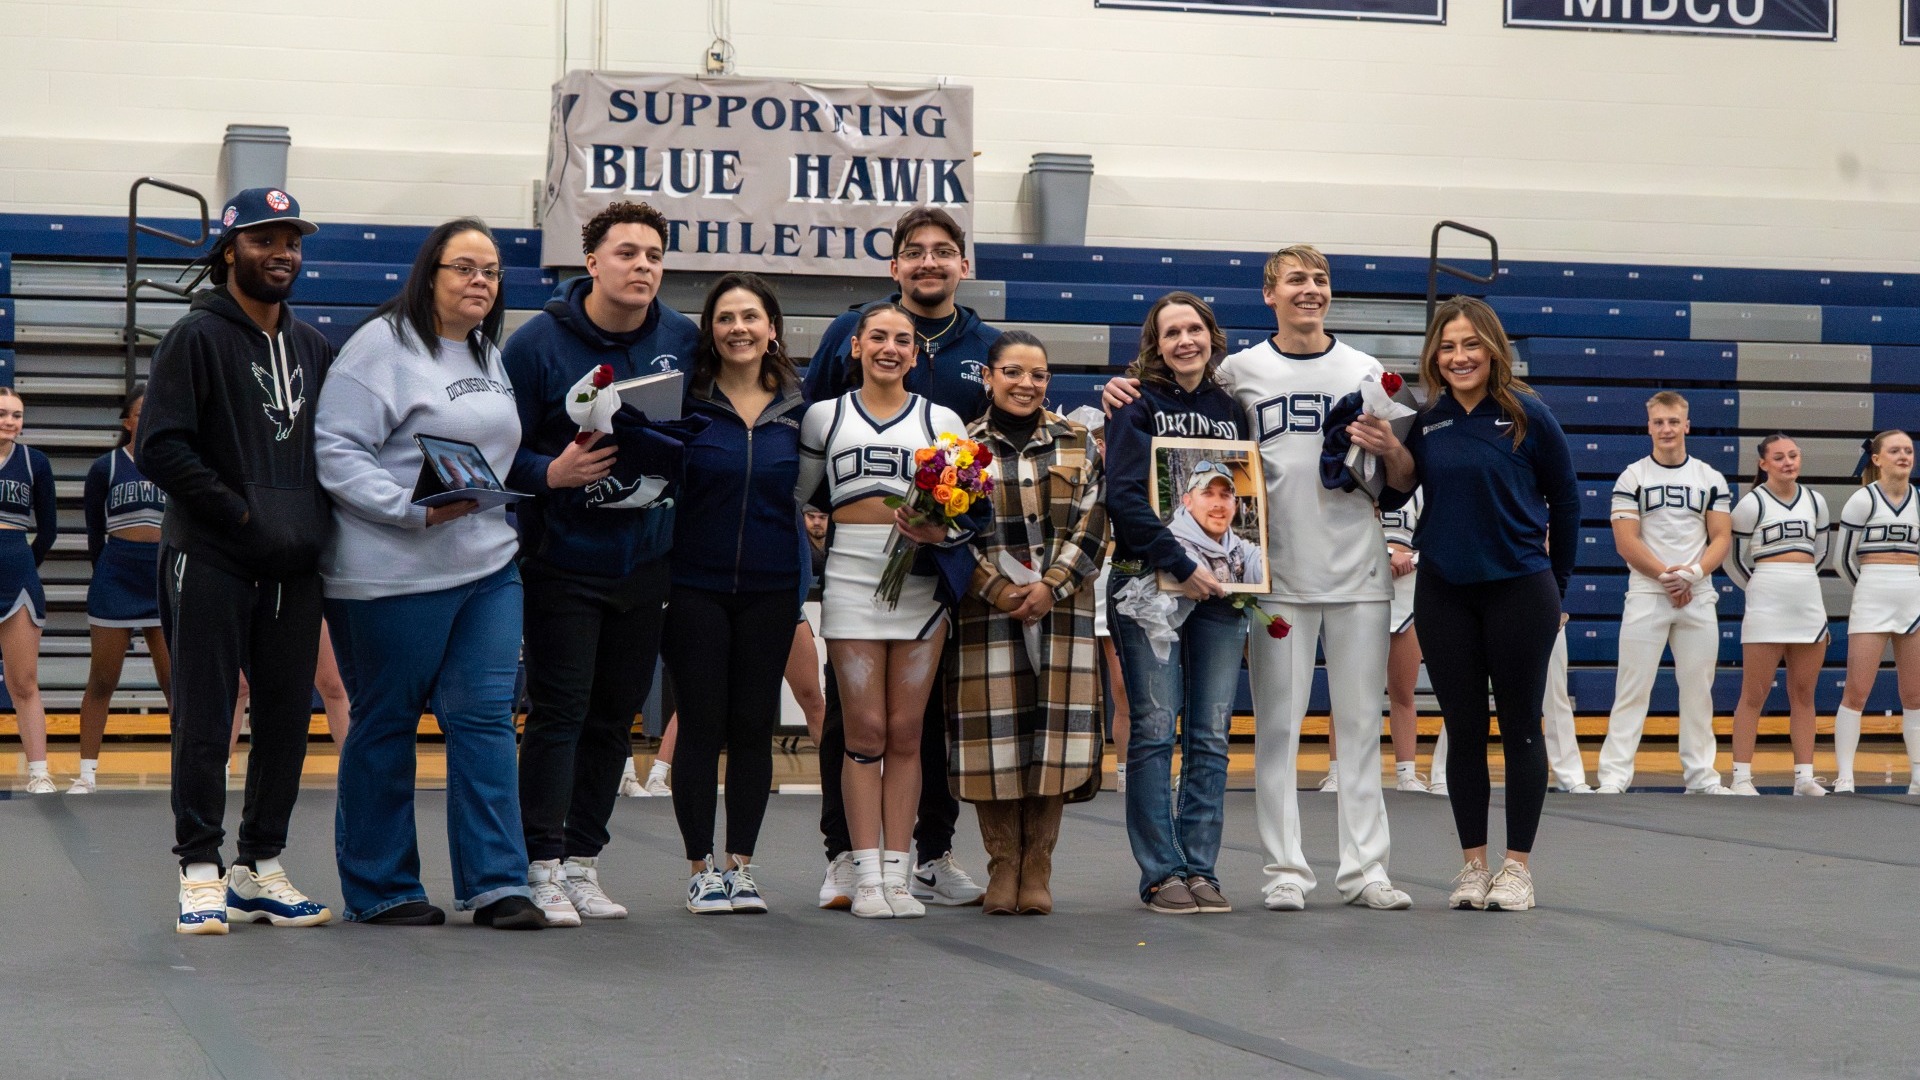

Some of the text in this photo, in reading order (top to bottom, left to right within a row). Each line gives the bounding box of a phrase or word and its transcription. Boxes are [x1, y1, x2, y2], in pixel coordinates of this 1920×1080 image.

[608, 89, 947, 139] SUPPORTING
[584, 143, 969, 208] BLUE HAWK
[664, 219, 894, 261] THLETIC
[445, 377, 492, 401] DICKINSON
[960, 372, 986, 385] CHEE
[1154, 410, 1239, 440] DKINSO
[1254, 392, 1334, 444] DS
[0, 479, 30, 507] KS
